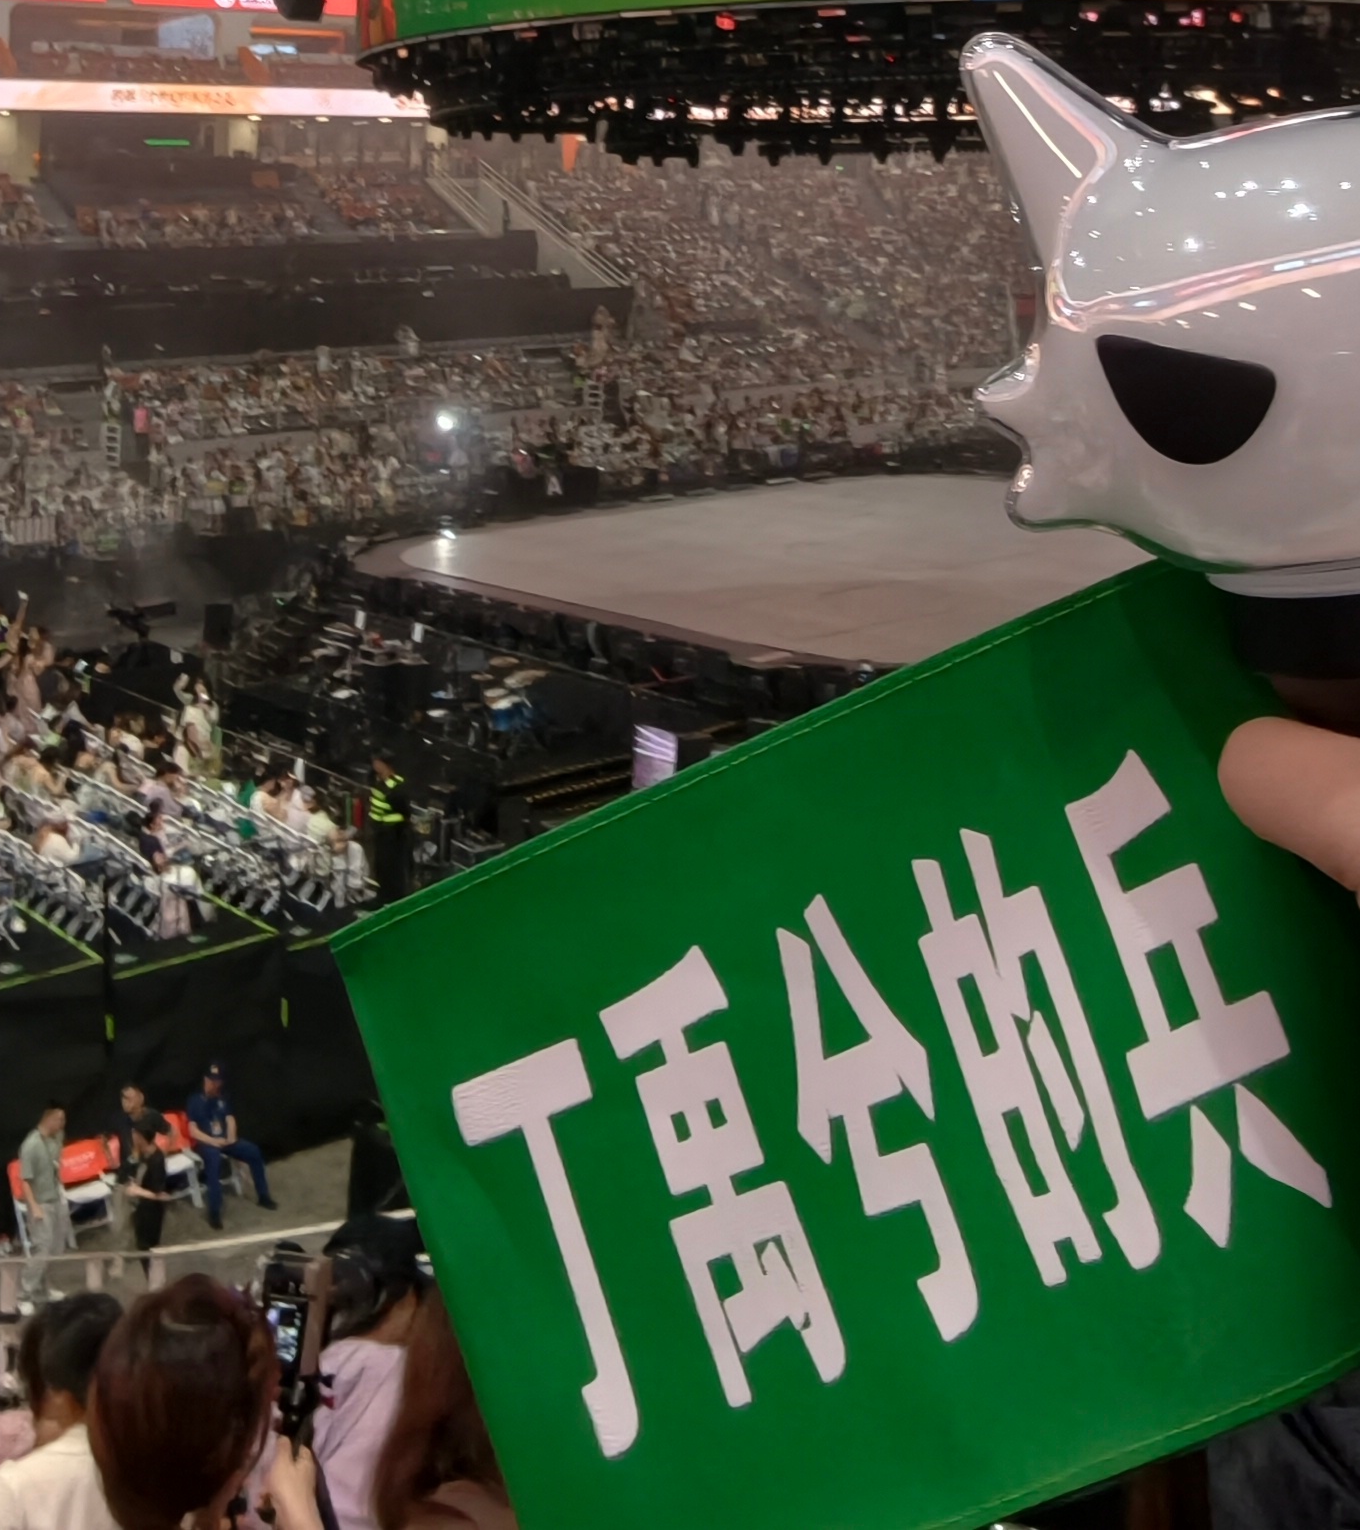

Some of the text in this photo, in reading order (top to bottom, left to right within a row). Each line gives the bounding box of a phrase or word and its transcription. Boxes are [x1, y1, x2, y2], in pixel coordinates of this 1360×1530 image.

[451, 750, 1332, 1456] 丁禹兮的兵
